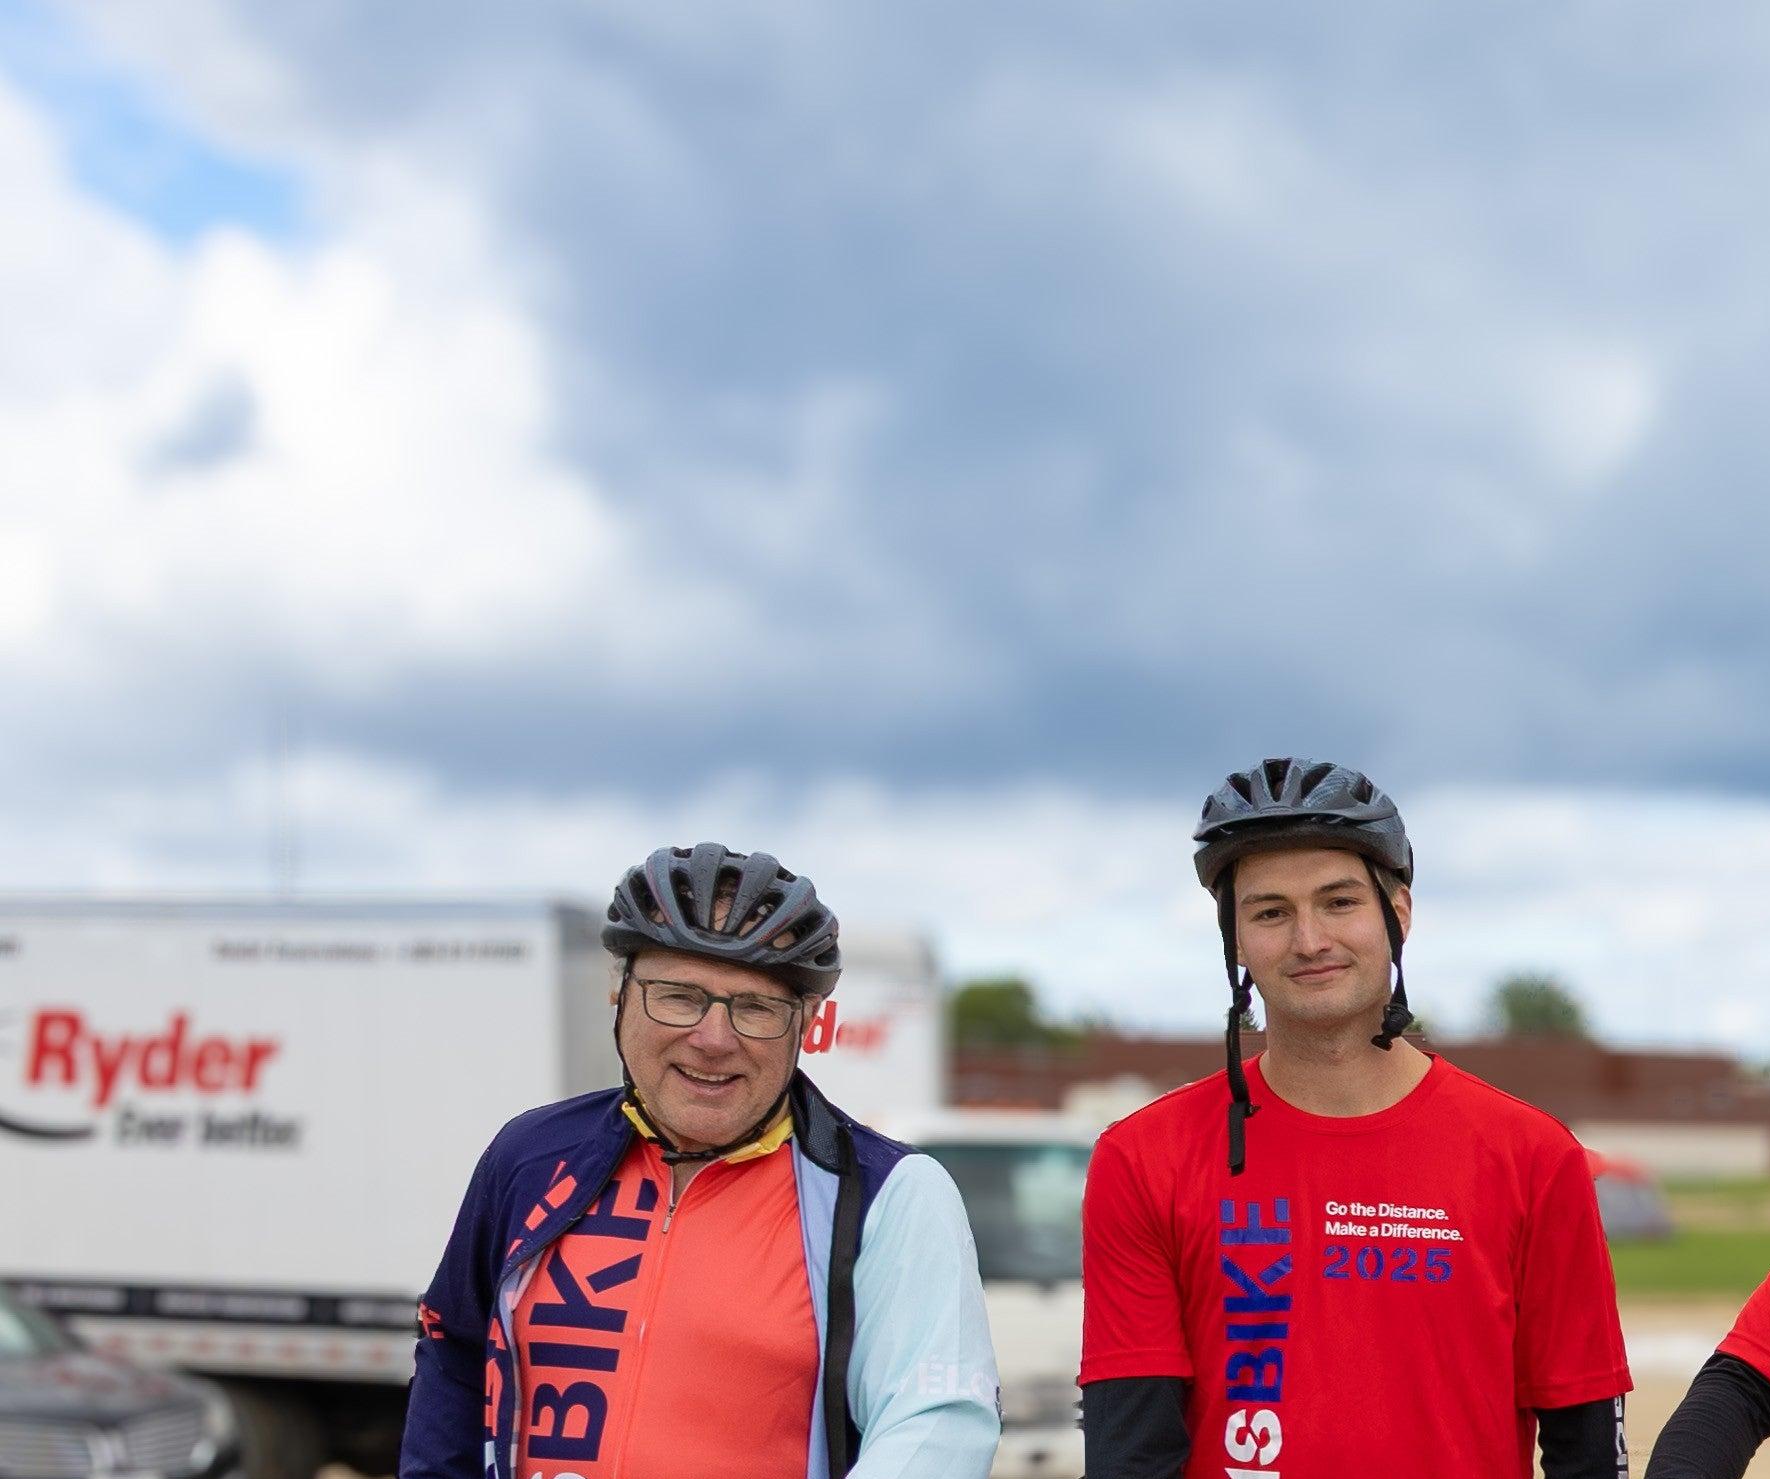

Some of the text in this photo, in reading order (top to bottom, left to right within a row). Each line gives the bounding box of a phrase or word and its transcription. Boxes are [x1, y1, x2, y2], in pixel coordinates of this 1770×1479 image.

[25, 1008, 278, 1110] Ryder
[1325, 1201, 1449, 1221] Go the Distance.
[1325, 1221, 1464, 1242] Make a Difference.
[1323, 1246, 1453, 1283] 2025
